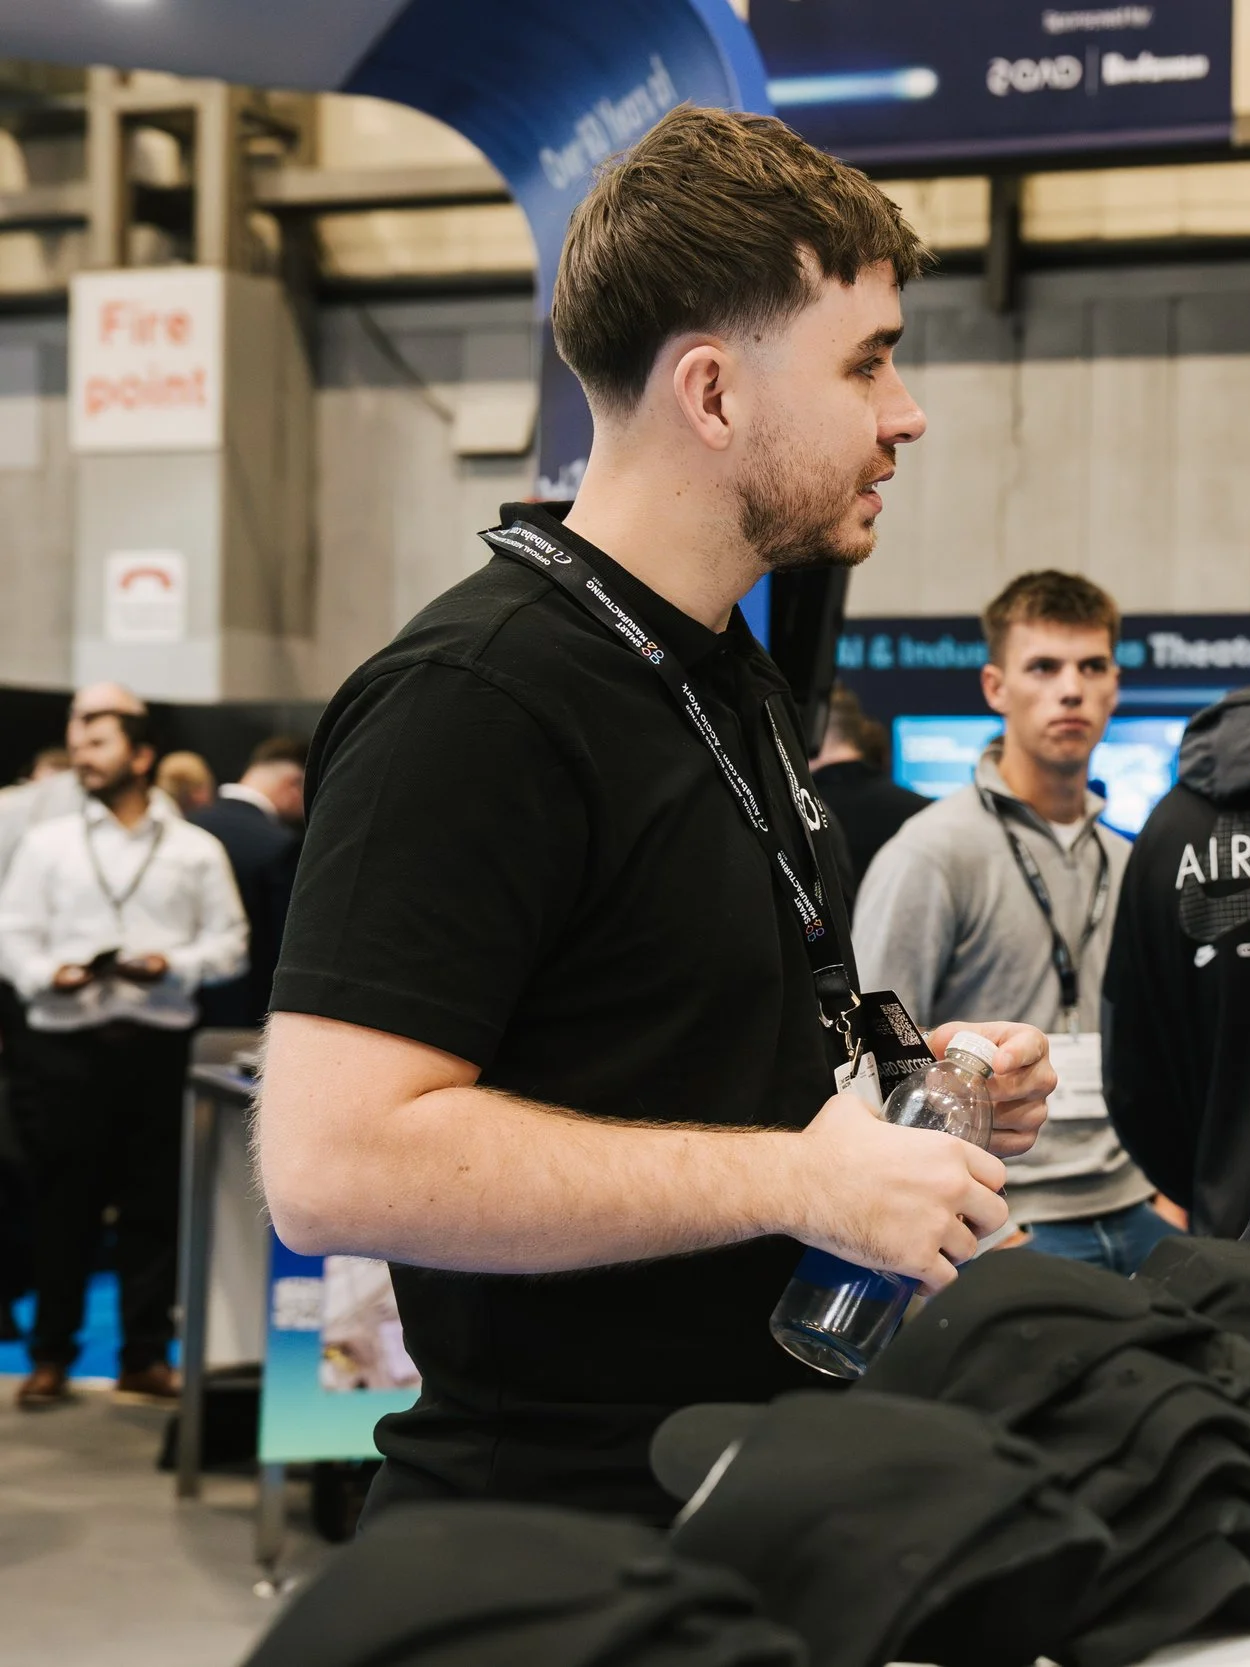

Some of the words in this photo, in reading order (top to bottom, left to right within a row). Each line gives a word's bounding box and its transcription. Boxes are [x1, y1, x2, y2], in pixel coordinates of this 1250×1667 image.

[99, 299, 194, 347] Fire
[83, 363, 206, 418] point
[523, 545, 551, 566] OFFICIAL
[586, 580, 648, 643] MANUFACTURING
[615, 622, 643, 648] SMART
[682, 683, 700, 715] Work
[685, 705, 705, 735] PARTNER
[700, 714, 721, 746] Accio
[705, 735, 725, 768] BUSINESS
[722, 754, 760, 816] Alibaba.com
[724, 769, 742, 796] AGENTIC
[742, 798, 758, 828] OFFICIAL
[777, 852, 817, 920] MANUFACTURING
[794, 897, 811, 924] SMART
